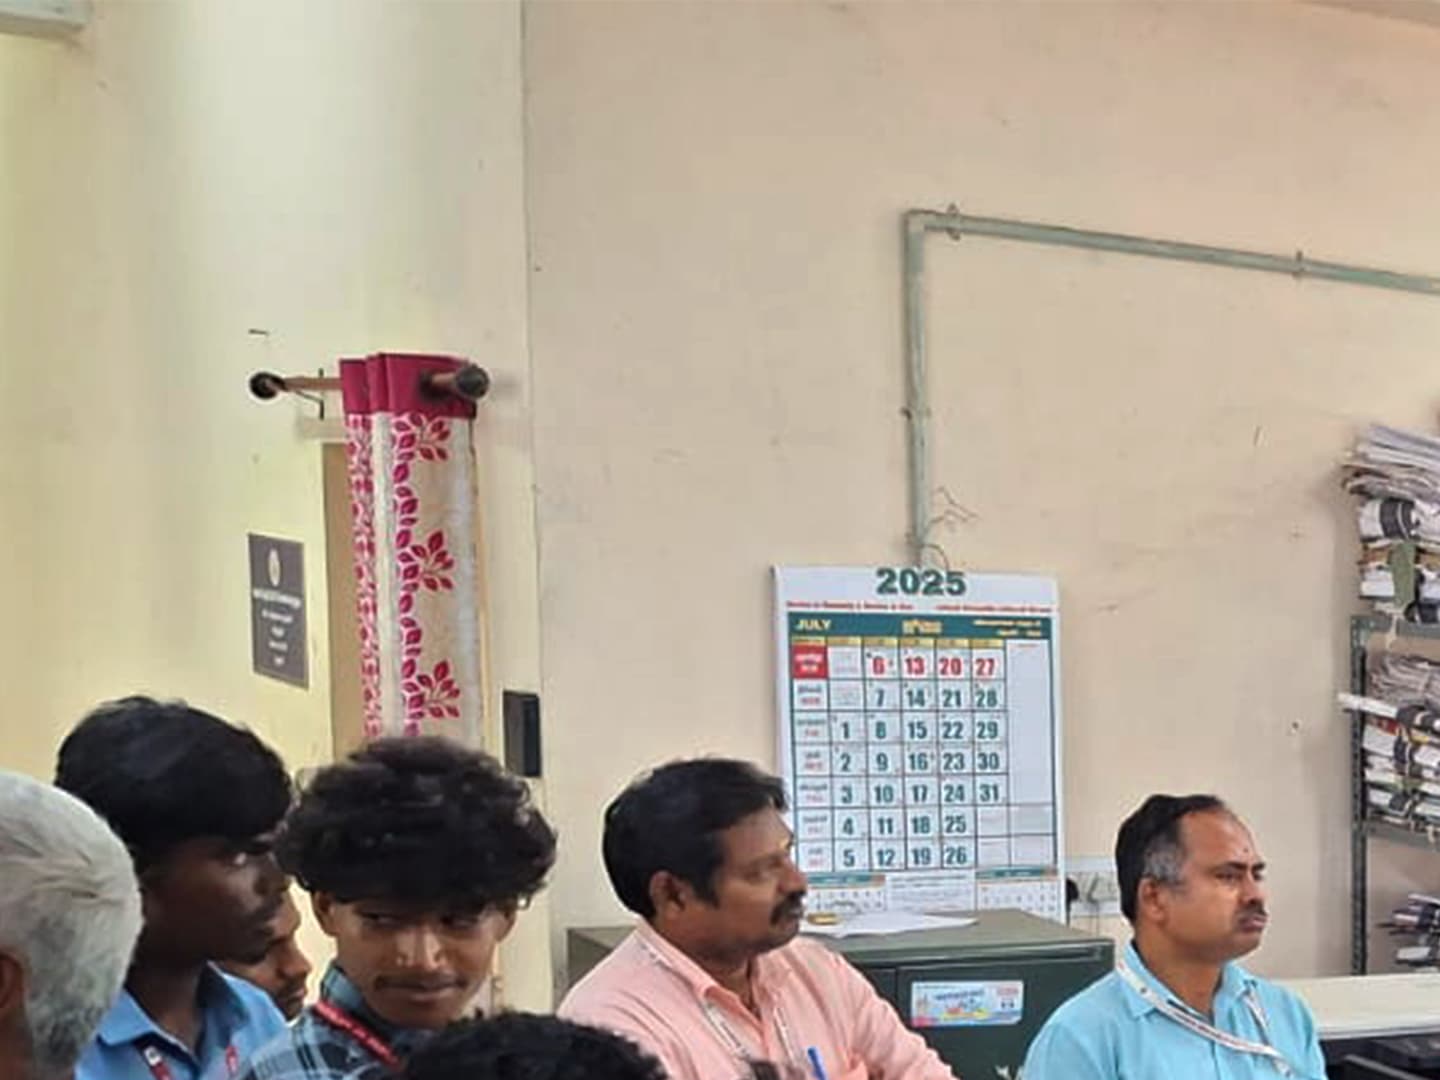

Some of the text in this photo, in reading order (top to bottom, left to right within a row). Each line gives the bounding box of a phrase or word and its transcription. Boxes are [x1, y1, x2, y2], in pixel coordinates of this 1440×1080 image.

[876, 568, 966, 596] 2025
[794, 619, 832, 632] JULY
[872, 656, 995, 676] 6 13 20 27
[876, 689, 997, 707] 7 14 21 28
[841, 722, 850, 739] 1
[876, 721, 886, 739] 8
[908, 721, 927, 739] 15
[942, 722, 963, 739] 22
[977, 721, 998, 739] 29
[840, 753, 851, 772] 2
[876, 753, 888, 771] 9
[909, 753, 928, 770] 16
[943, 752, 965, 770] 23
[978, 752, 999, 770] 30
[841, 786, 853, 804] 3
[875, 785, 893, 803] 10
[912, 785, 928, 802] 17
[943, 785, 966, 803] 24
[980, 784, 998, 802] 31
[842, 818, 854, 835] 4
[878, 818, 893, 834] 11
[912, 816, 930, 834] 18
[945, 816, 967, 834] 25
[844, 849, 855, 867] 5
[877, 849, 895, 866] 12
[912, 847, 931, 865] 19
[946, 847, 967, 865] 26
